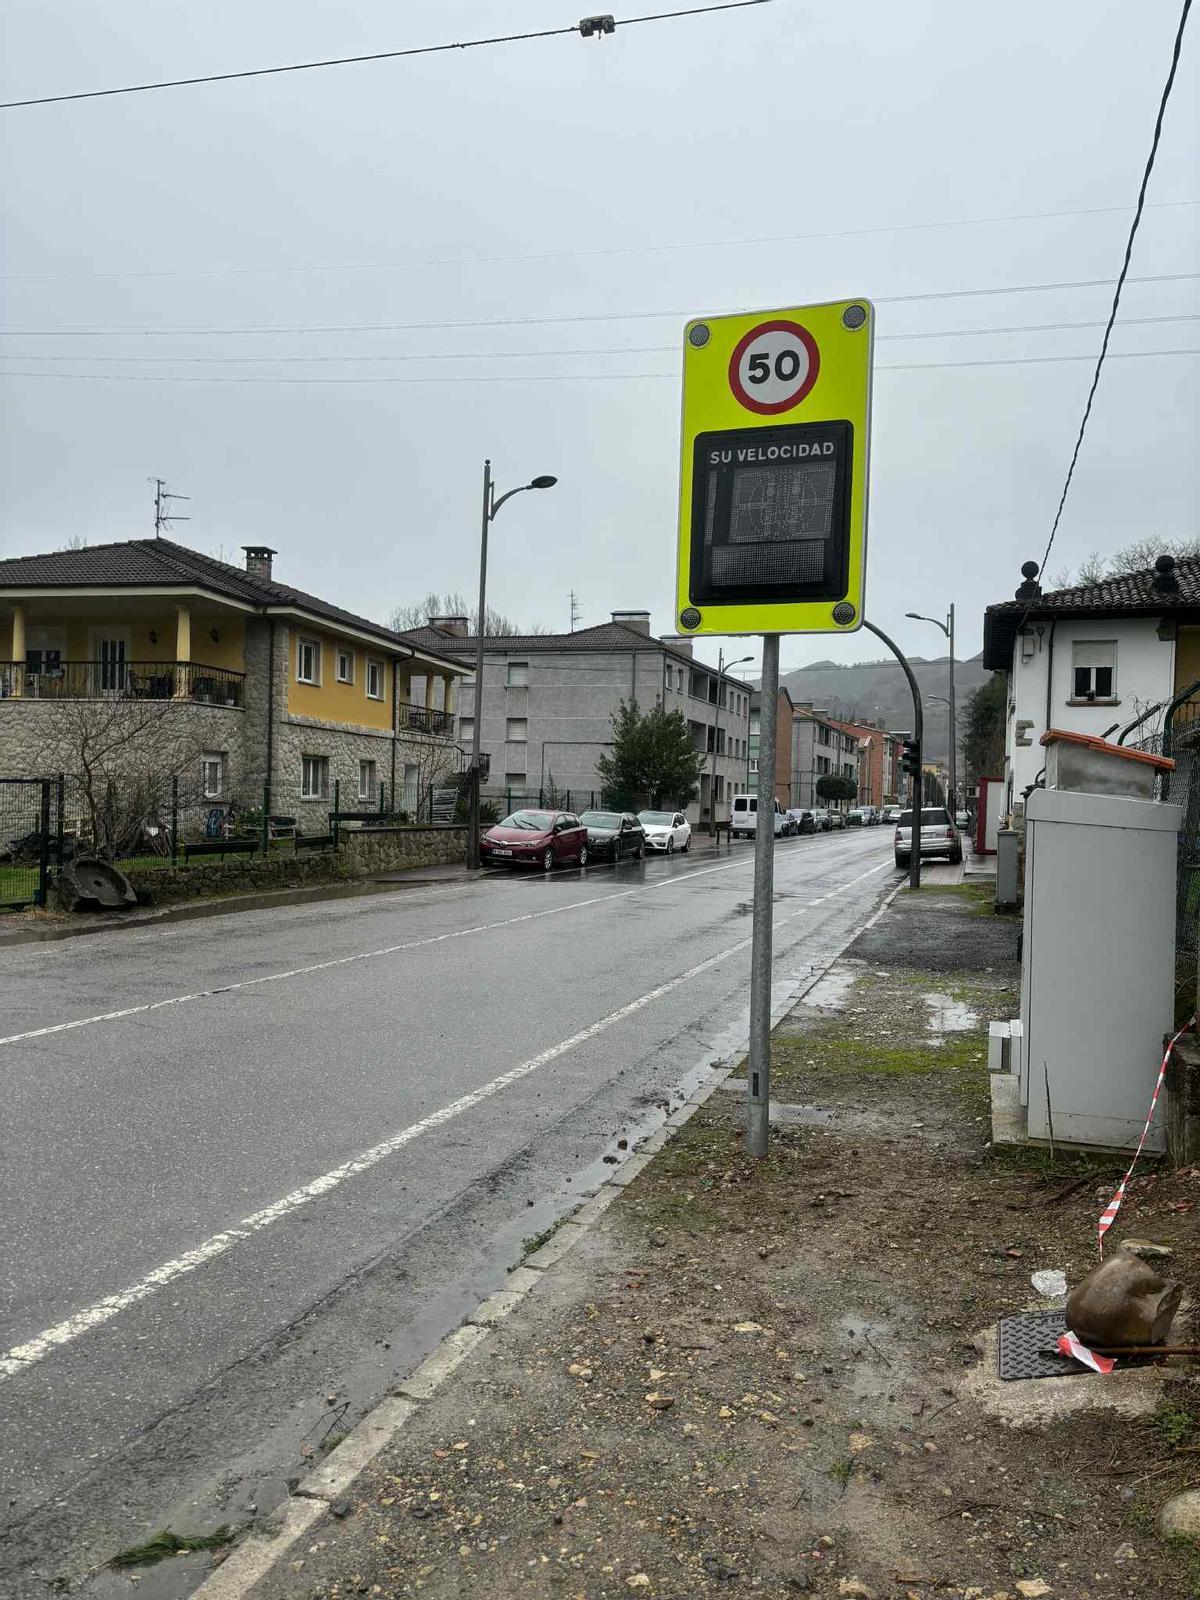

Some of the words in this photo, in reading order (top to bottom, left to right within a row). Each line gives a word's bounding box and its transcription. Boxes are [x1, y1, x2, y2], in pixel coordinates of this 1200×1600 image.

[748, 350, 800, 384] 50
[709, 450, 732, 464] SU
[737, 442, 835, 462] VELOCIDAD
